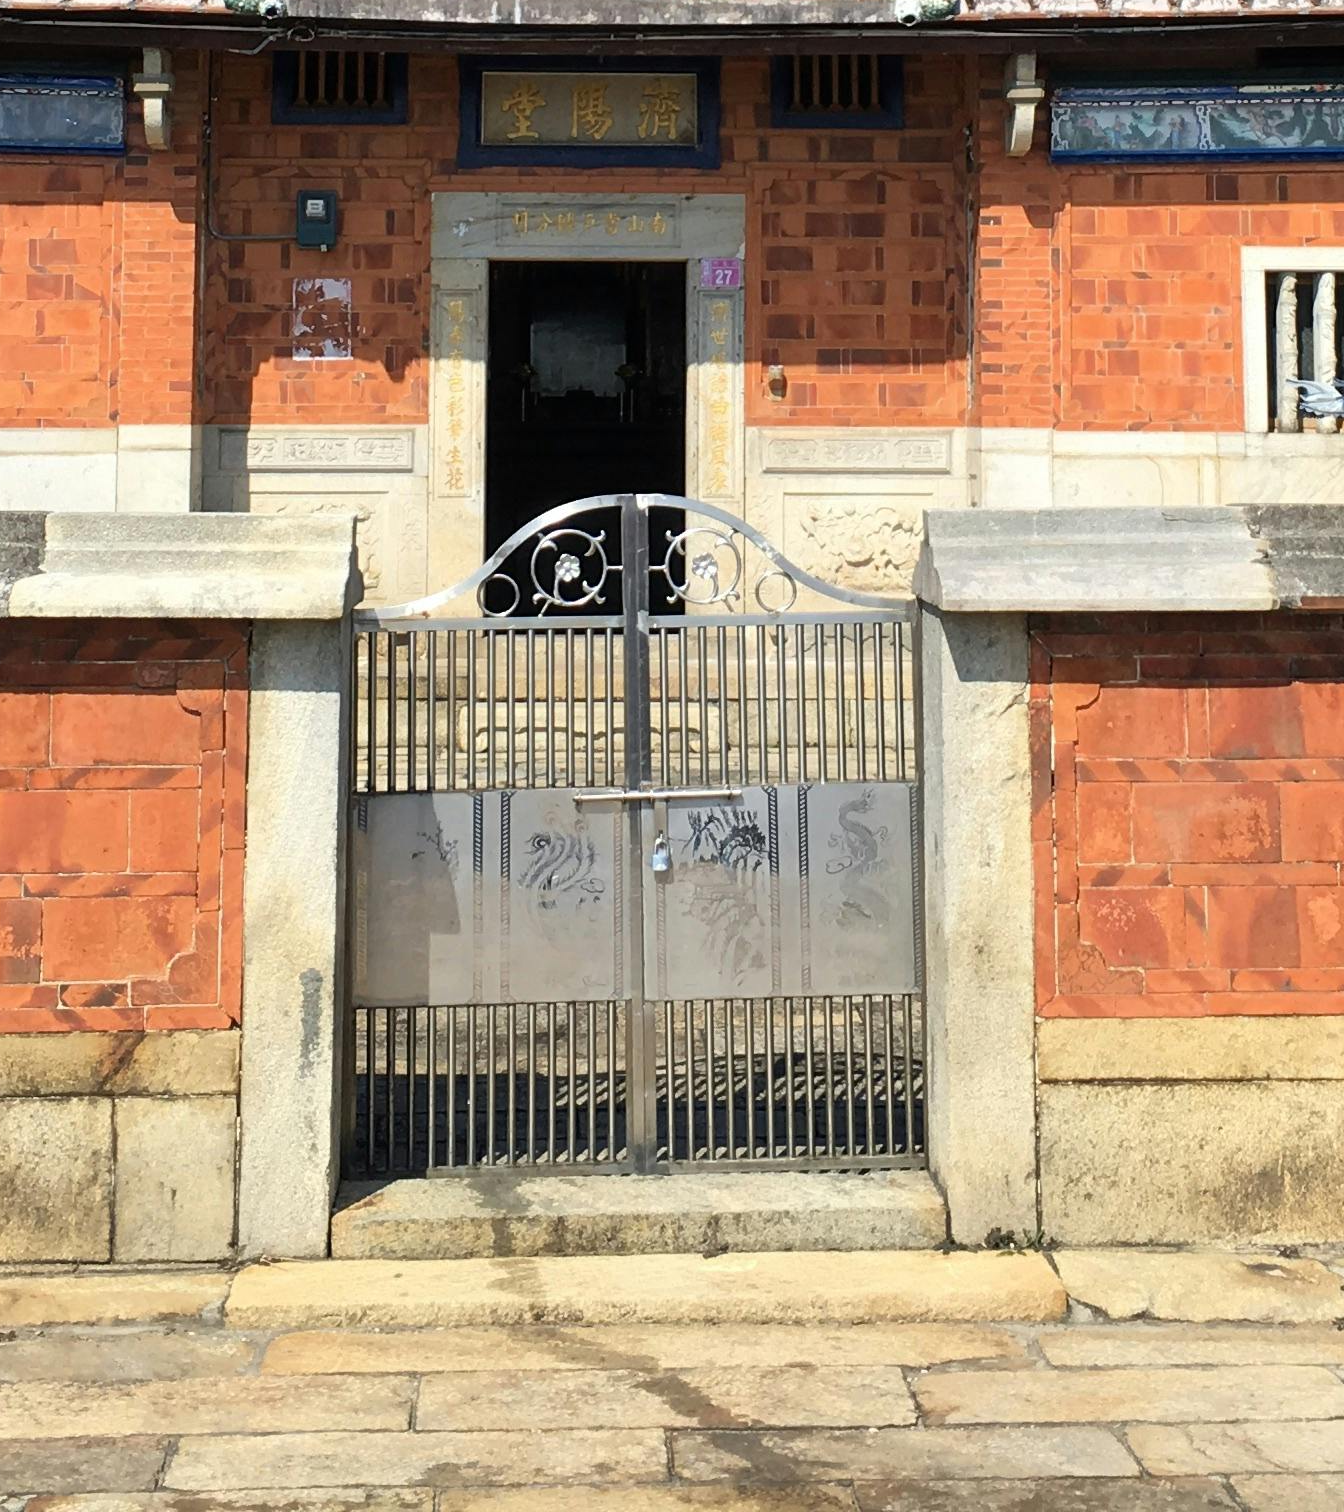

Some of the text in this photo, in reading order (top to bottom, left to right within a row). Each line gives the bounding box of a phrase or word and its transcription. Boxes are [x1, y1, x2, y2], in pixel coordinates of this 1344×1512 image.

[500, 78, 682, 141] 濟陽堂
[715, 269, 733, 285] 27
